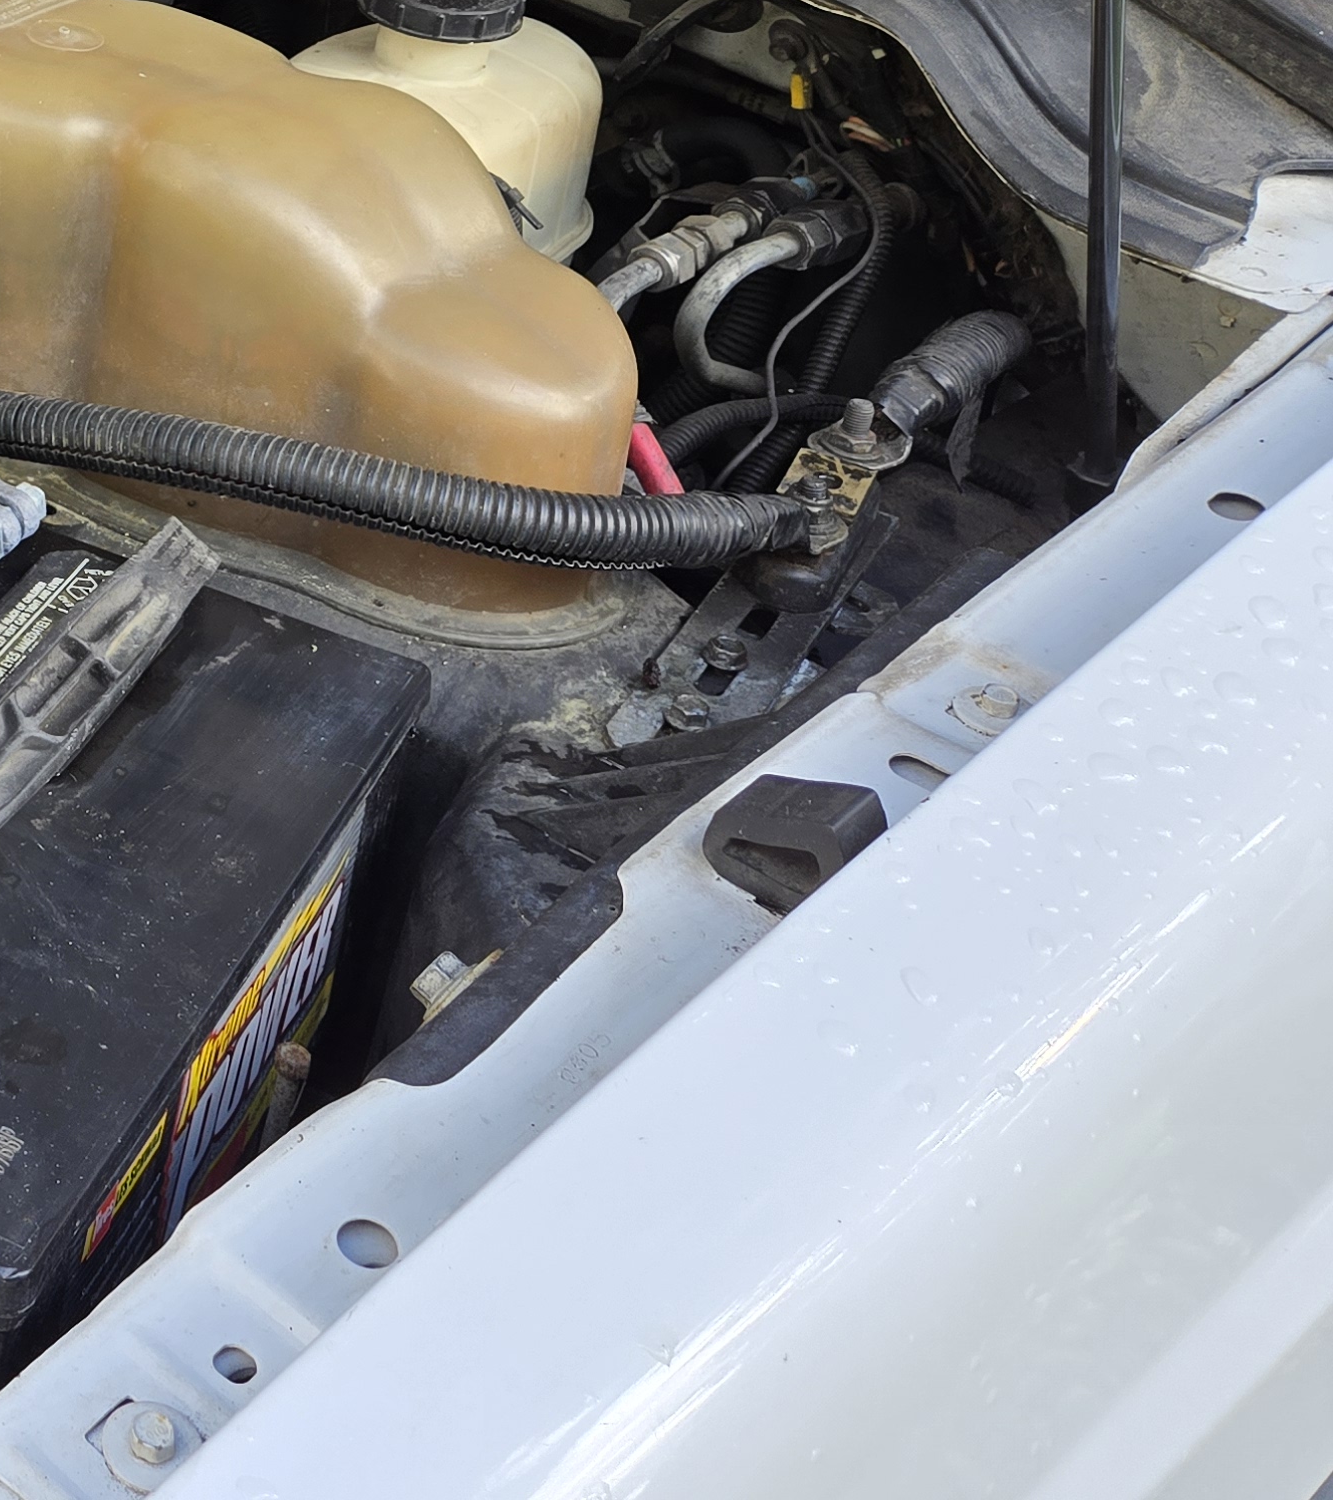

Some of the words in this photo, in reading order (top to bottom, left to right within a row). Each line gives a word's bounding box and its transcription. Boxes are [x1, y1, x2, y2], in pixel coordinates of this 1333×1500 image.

[0, 648, 21, 670] EYES
[12, 613, 53, 655] IMMEDIATELY
[163, 880, 344, 1238] POWER
